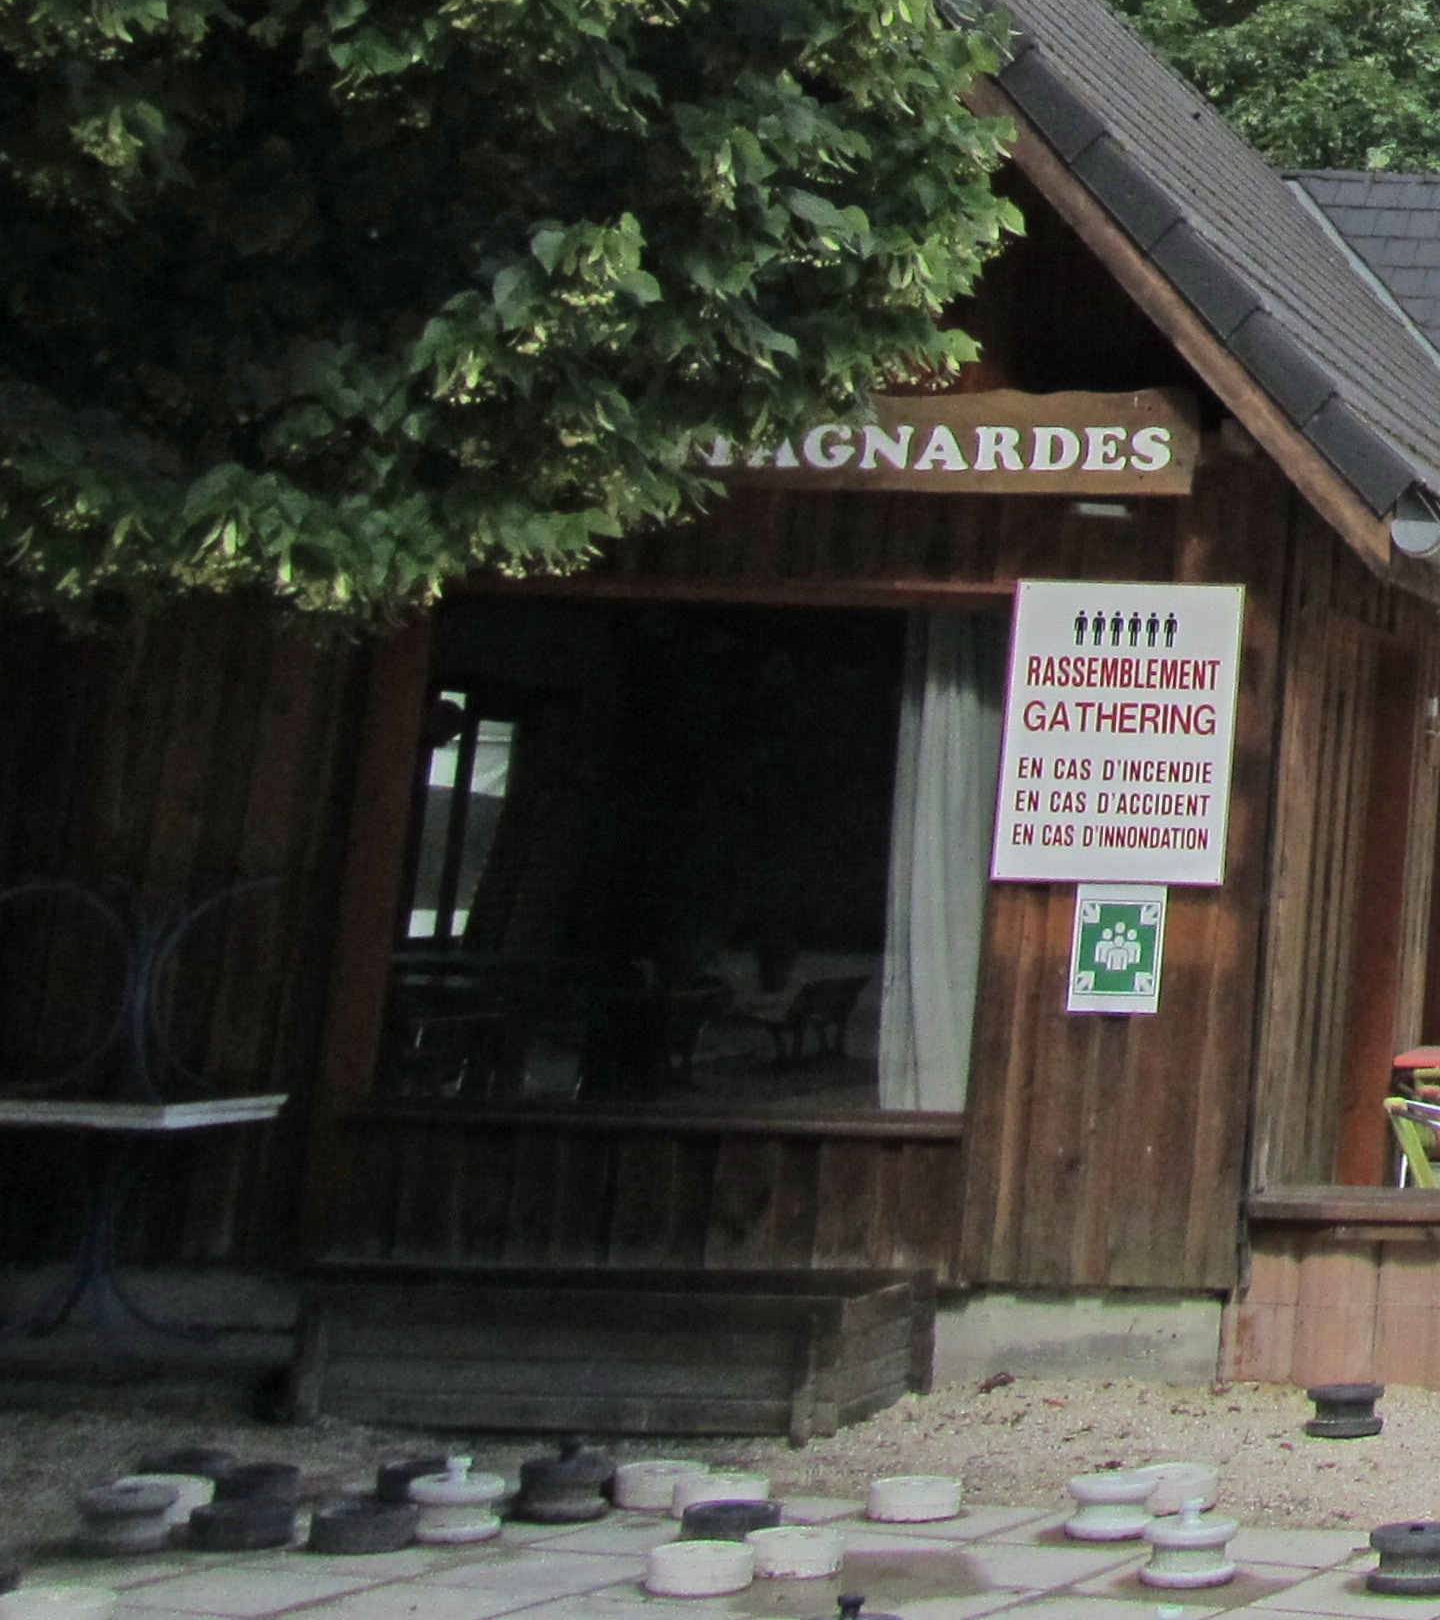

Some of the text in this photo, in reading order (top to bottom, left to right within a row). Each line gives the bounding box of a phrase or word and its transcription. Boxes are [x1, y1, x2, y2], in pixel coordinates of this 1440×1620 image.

[1026, 656, 1220, 690] RASSEMBLEMENT
[1023, 700, 1216, 735] GATHERING
[1018, 757, 1213, 784] EN CAS D'INCENDIE
[1015, 790, 1211, 817] EN CAS D'ACCIDENT
[1012, 823, 1208, 850] EN CAS D'INNONDATION
